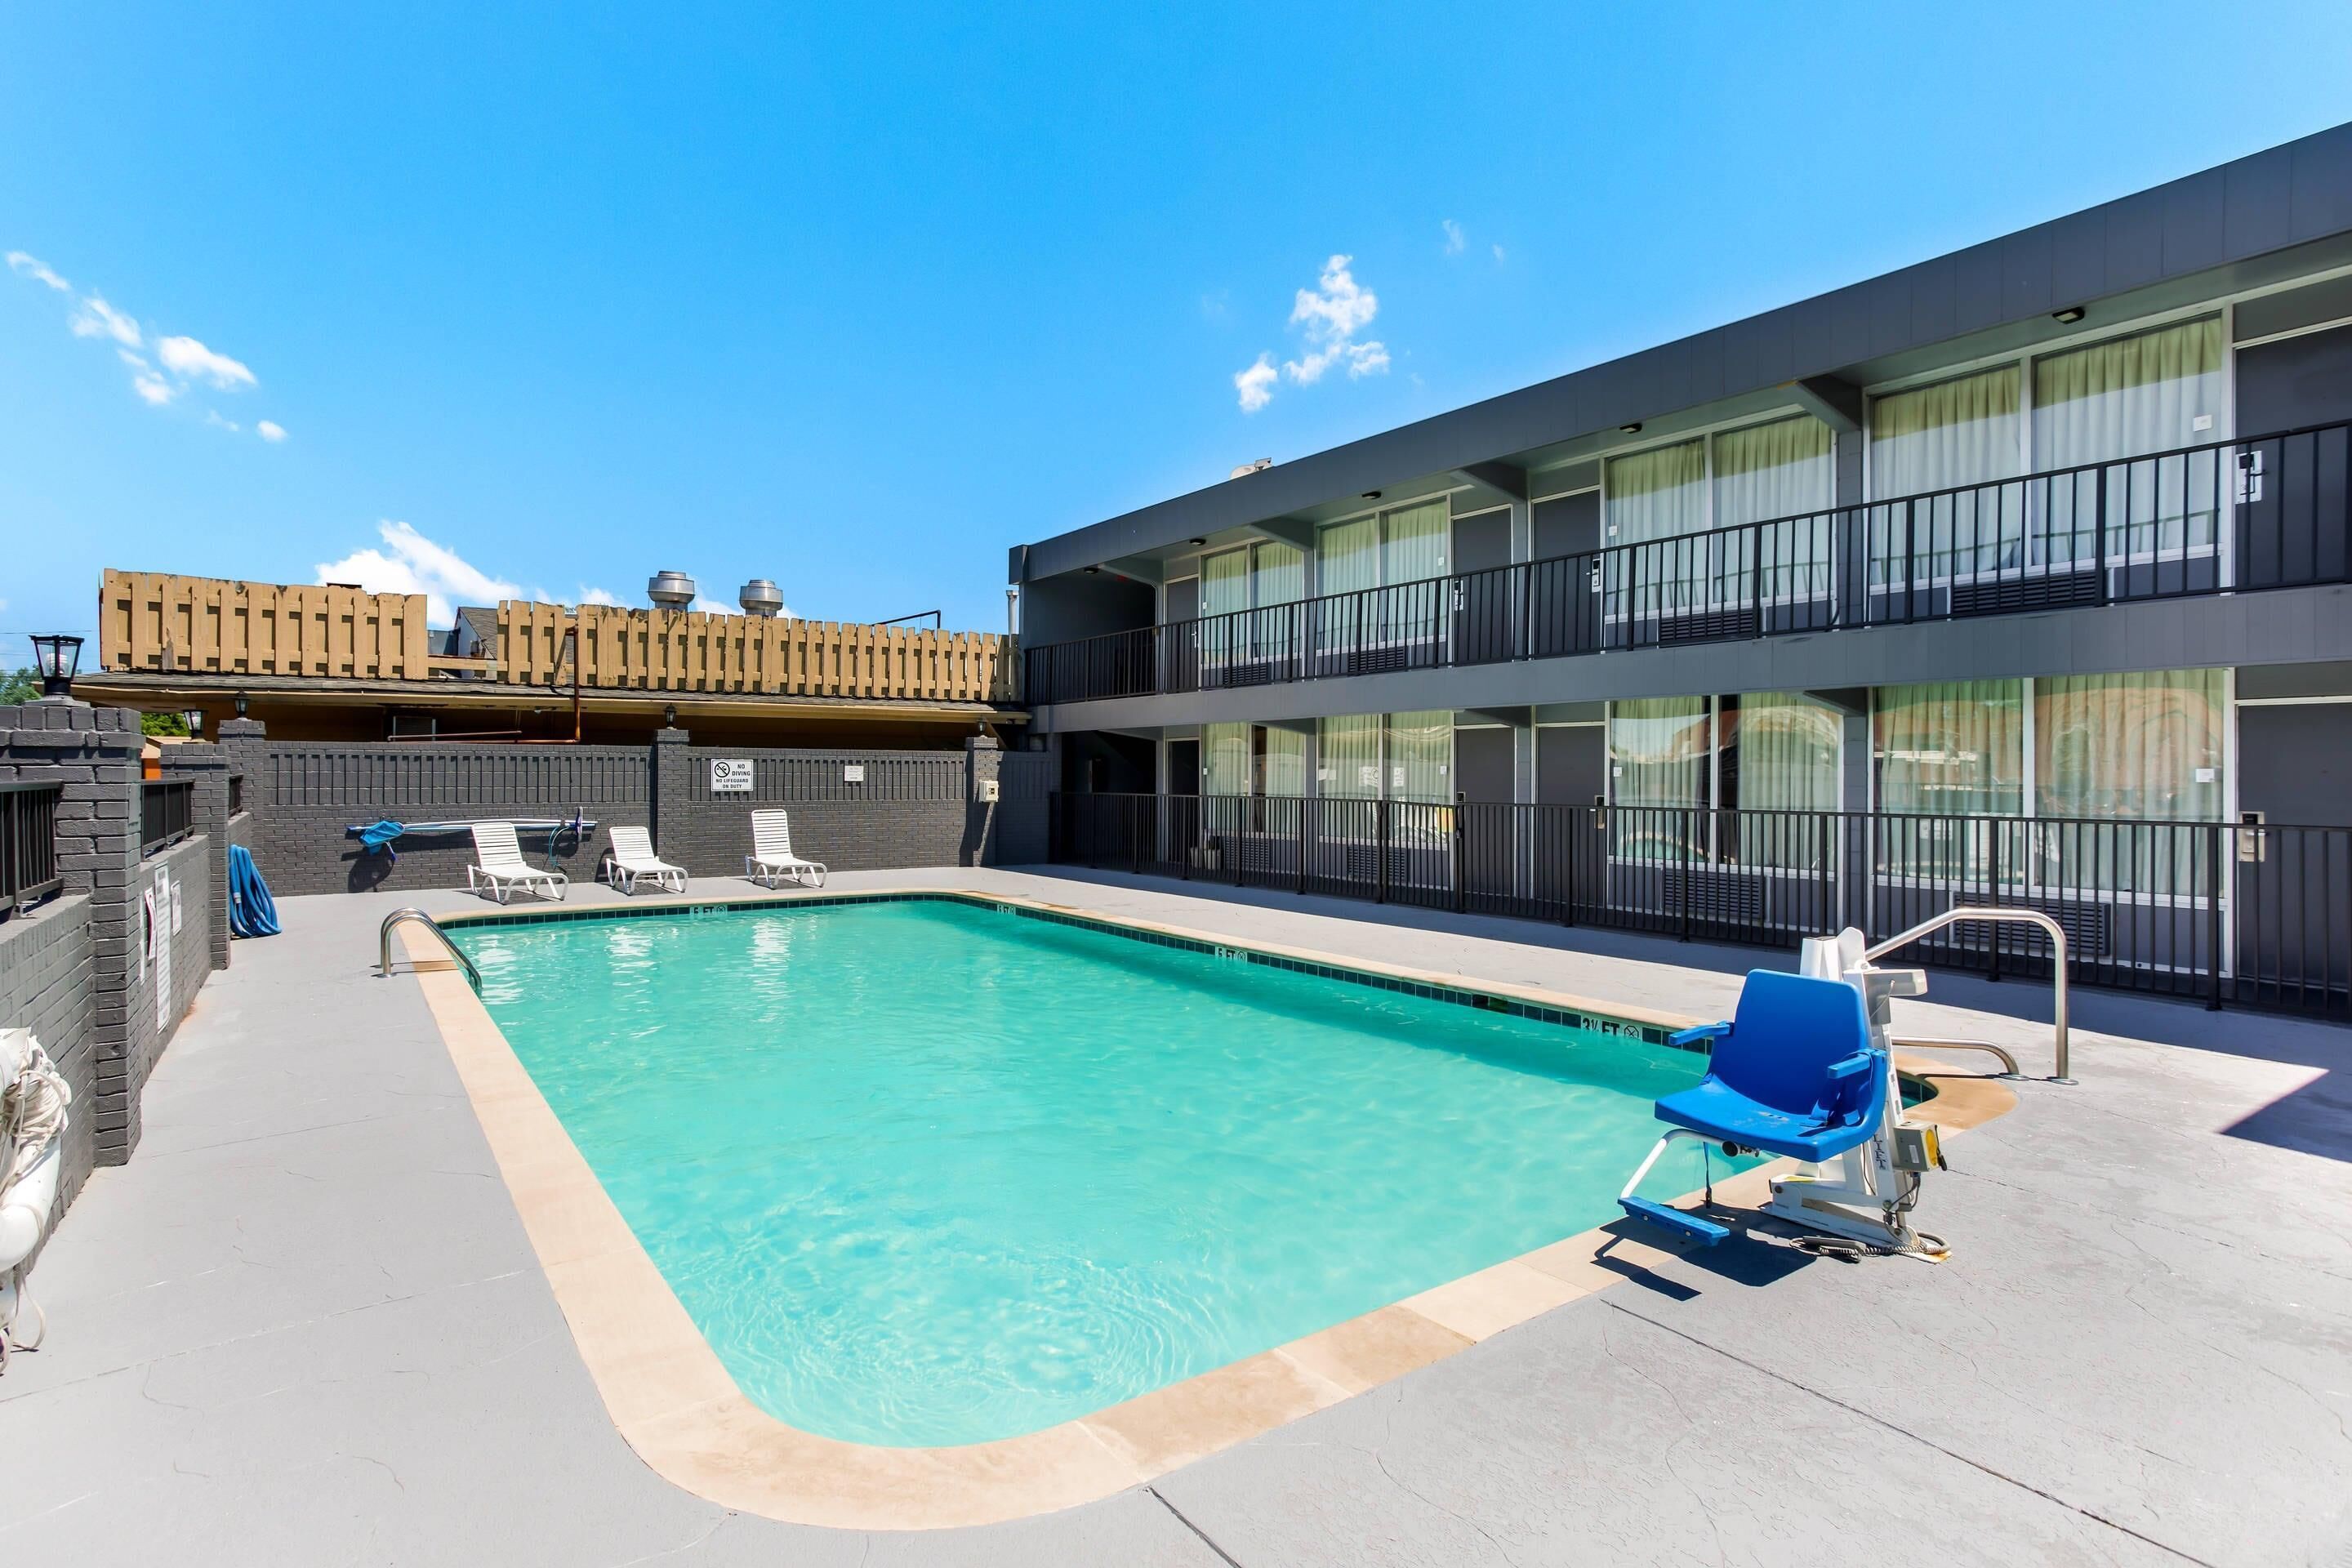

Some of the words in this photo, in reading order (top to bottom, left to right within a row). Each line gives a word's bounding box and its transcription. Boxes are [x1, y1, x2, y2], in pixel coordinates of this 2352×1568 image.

[1226, 949, 1236, 959] FT
[1602, 1020, 1619, 1036] FT
[1873, 1134, 1886, 1169] LIFT
